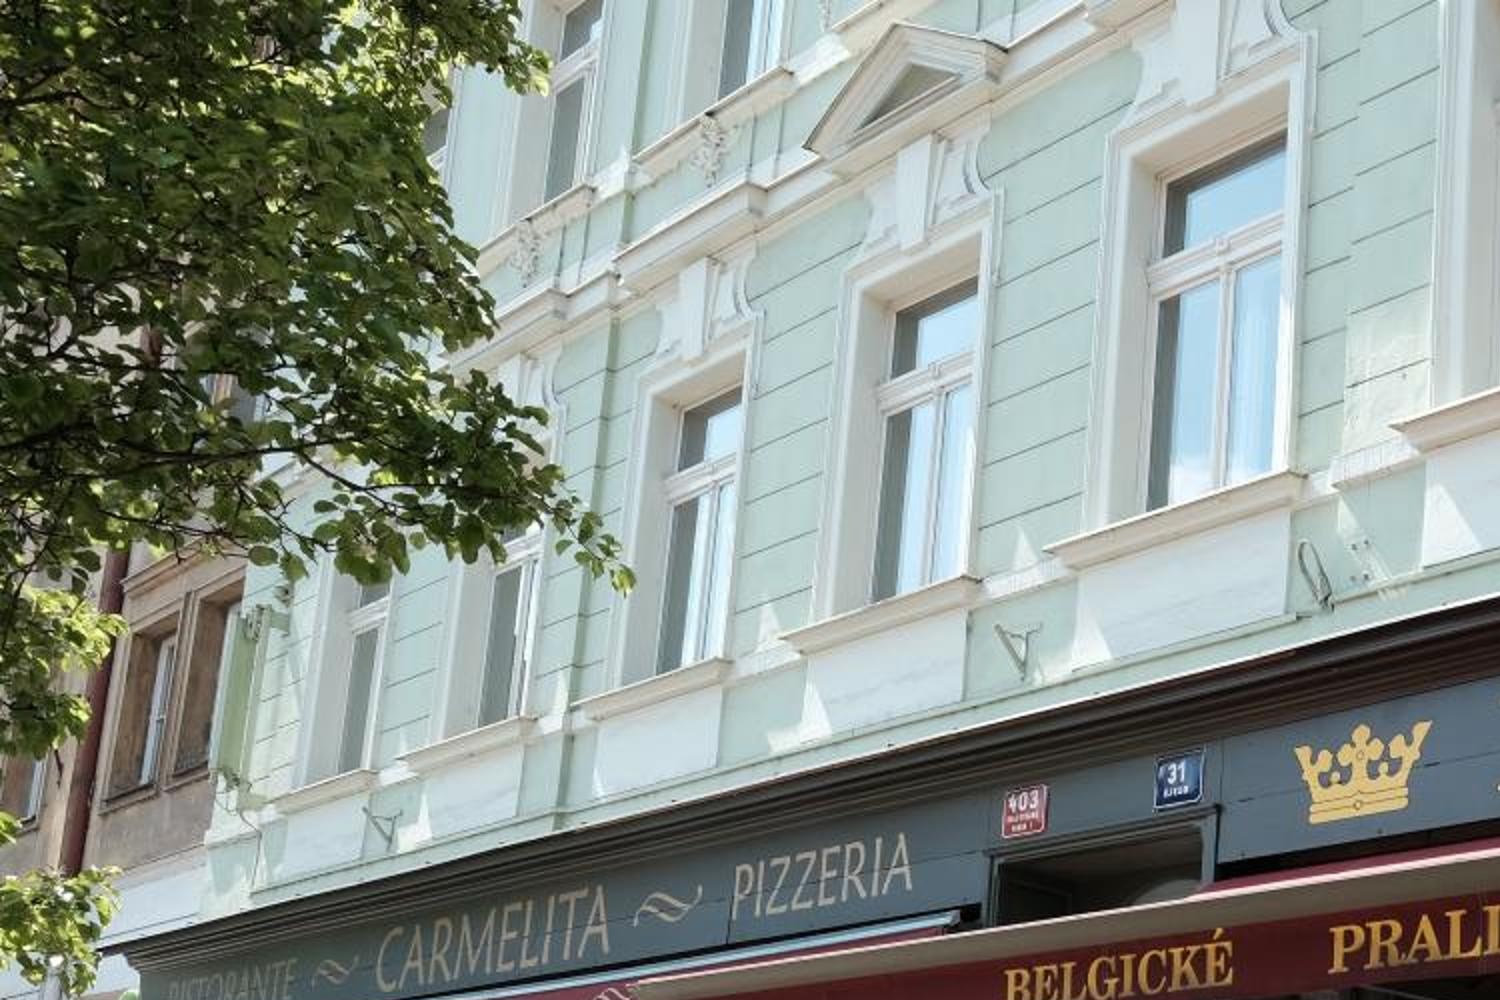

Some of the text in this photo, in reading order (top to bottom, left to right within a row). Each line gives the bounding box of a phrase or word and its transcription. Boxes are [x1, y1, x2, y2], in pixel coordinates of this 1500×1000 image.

[1167, 761, 1187, 785] 31
[376, 885, 610, 992] CARMELITA
[732, 833, 913, 919] PIZZERIA
